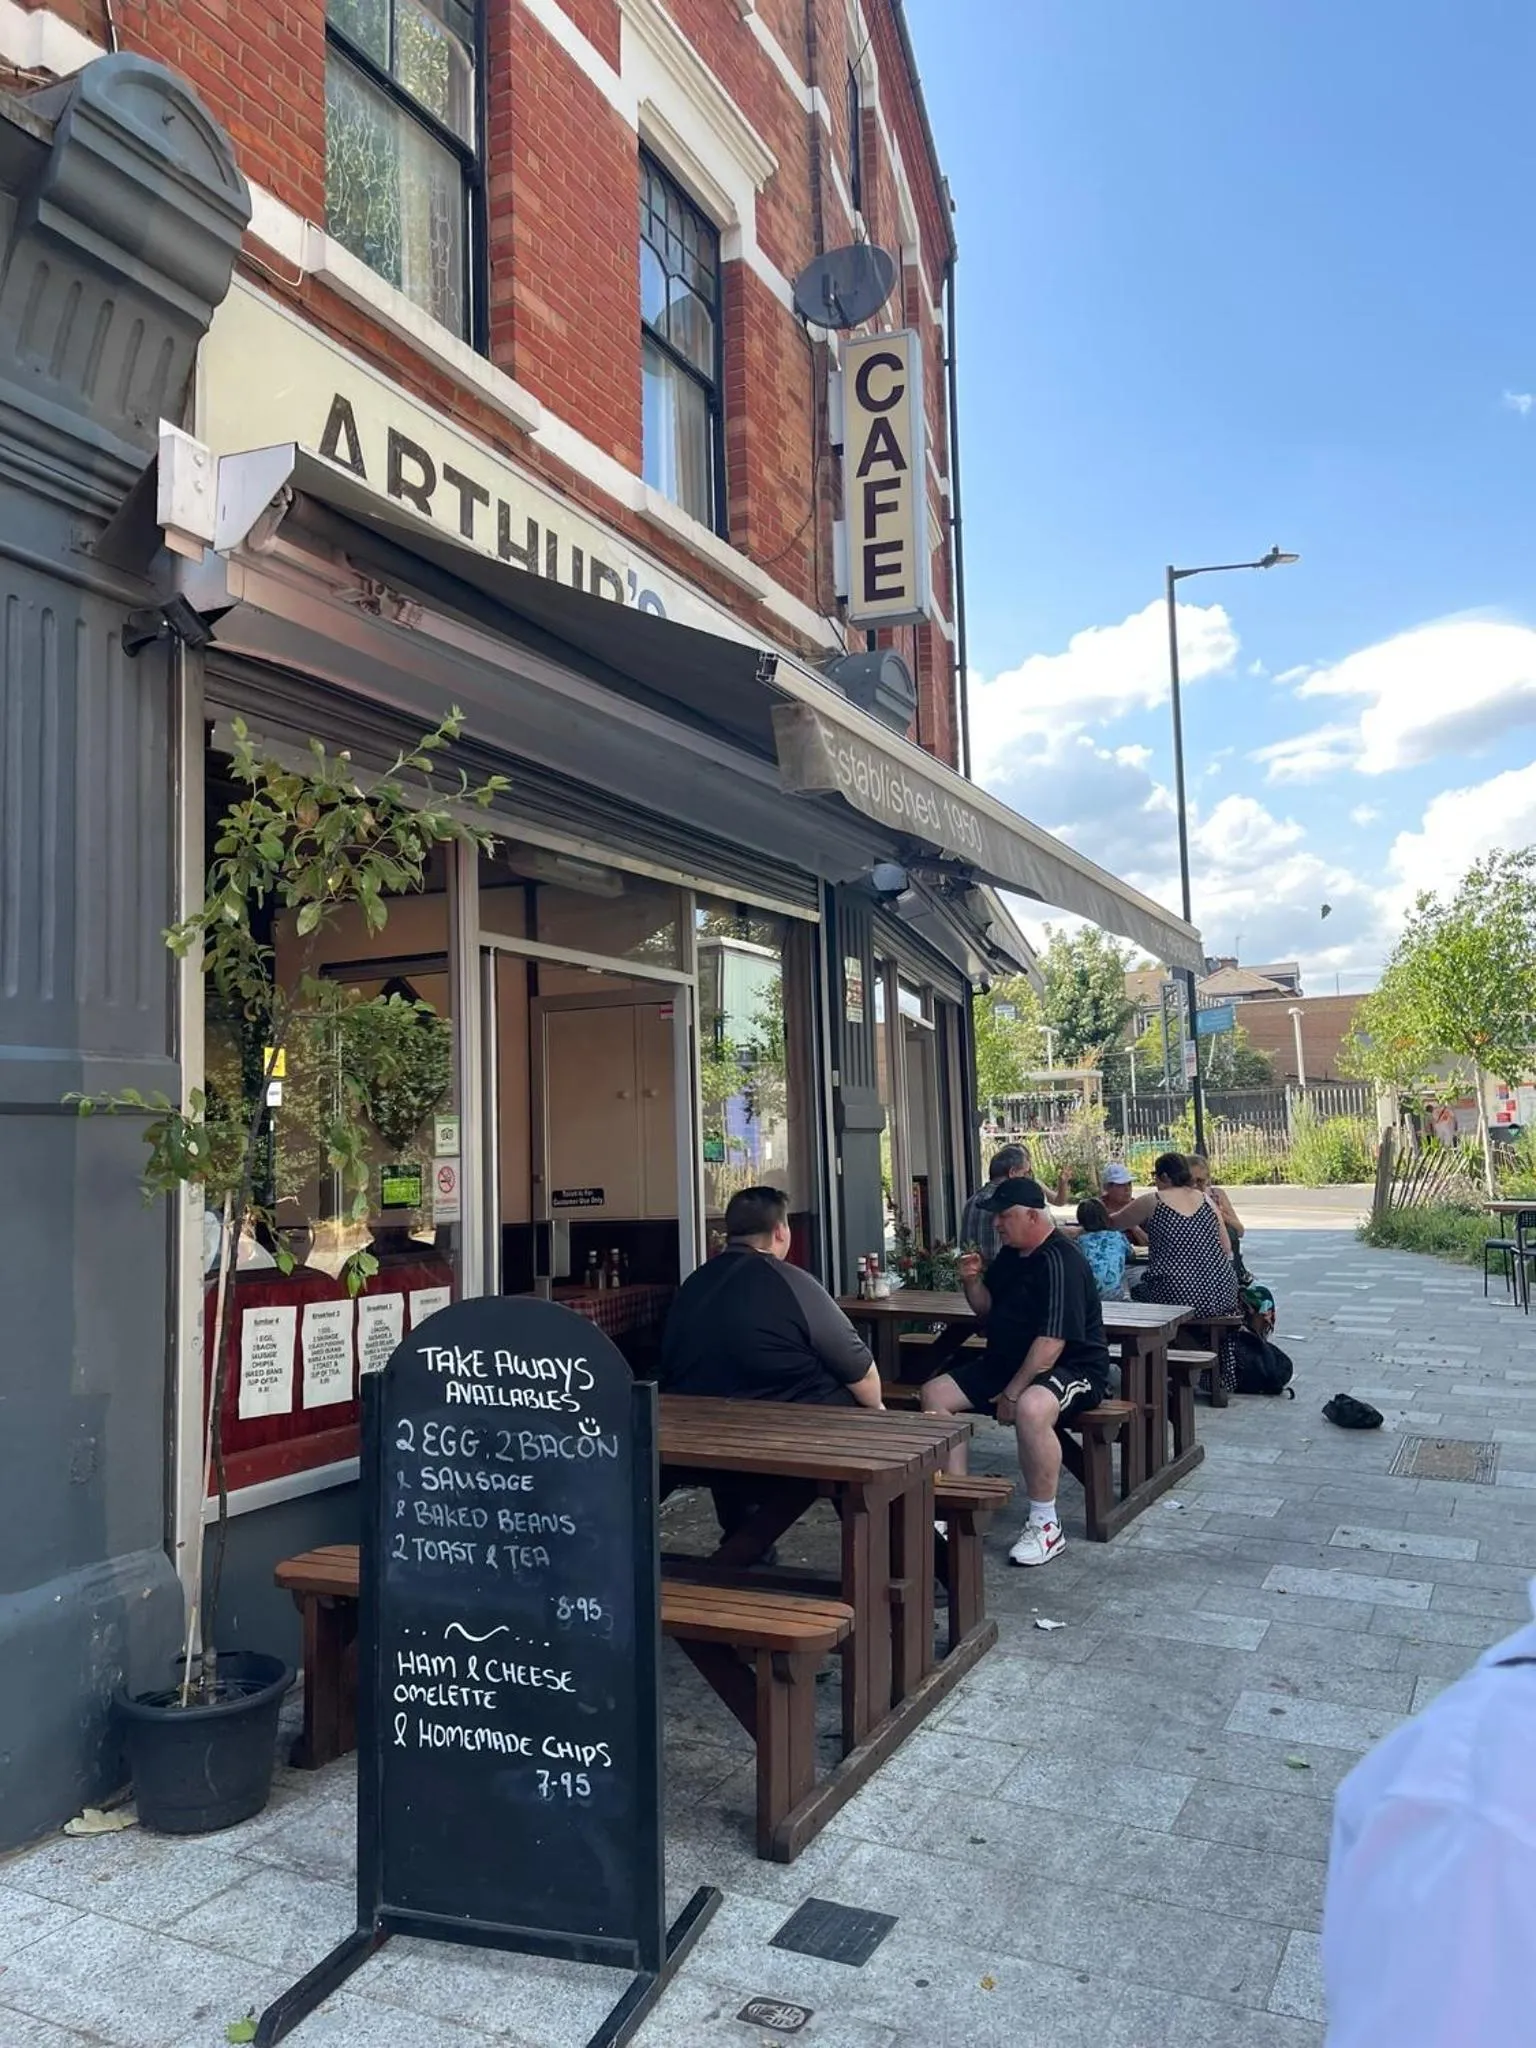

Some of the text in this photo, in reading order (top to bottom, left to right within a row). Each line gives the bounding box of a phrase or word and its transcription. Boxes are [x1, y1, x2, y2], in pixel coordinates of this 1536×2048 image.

[855, 352, 908, 603] CAFE
[820, 726, 983, 852] Established 1950
[417, 1345, 488, 1378] TAKE
[494, 1350, 595, 1393] AWAYS
[446, 1380, 580, 1412] AVAILABLES
[396, 1419, 415, 1452] 2
[421, 1466, 534, 1491] SAUSAGE
[413, 1501, 488, 1528] BAKED
[498, 1508, 576, 1535] BEANS
[412, 1538, 477, 1564] TOAST
[503, 1545, 550, 1569] TEA
[397, 1650, 457, 1679] HAM
[485, 1659, 576, 1693] CHEESE
[394, 1684, 497, 1709] OMELETTE
[419, 1718, 533, 1757] HOMEMADE
[542, 1736, 612, 1767] CHIPS
